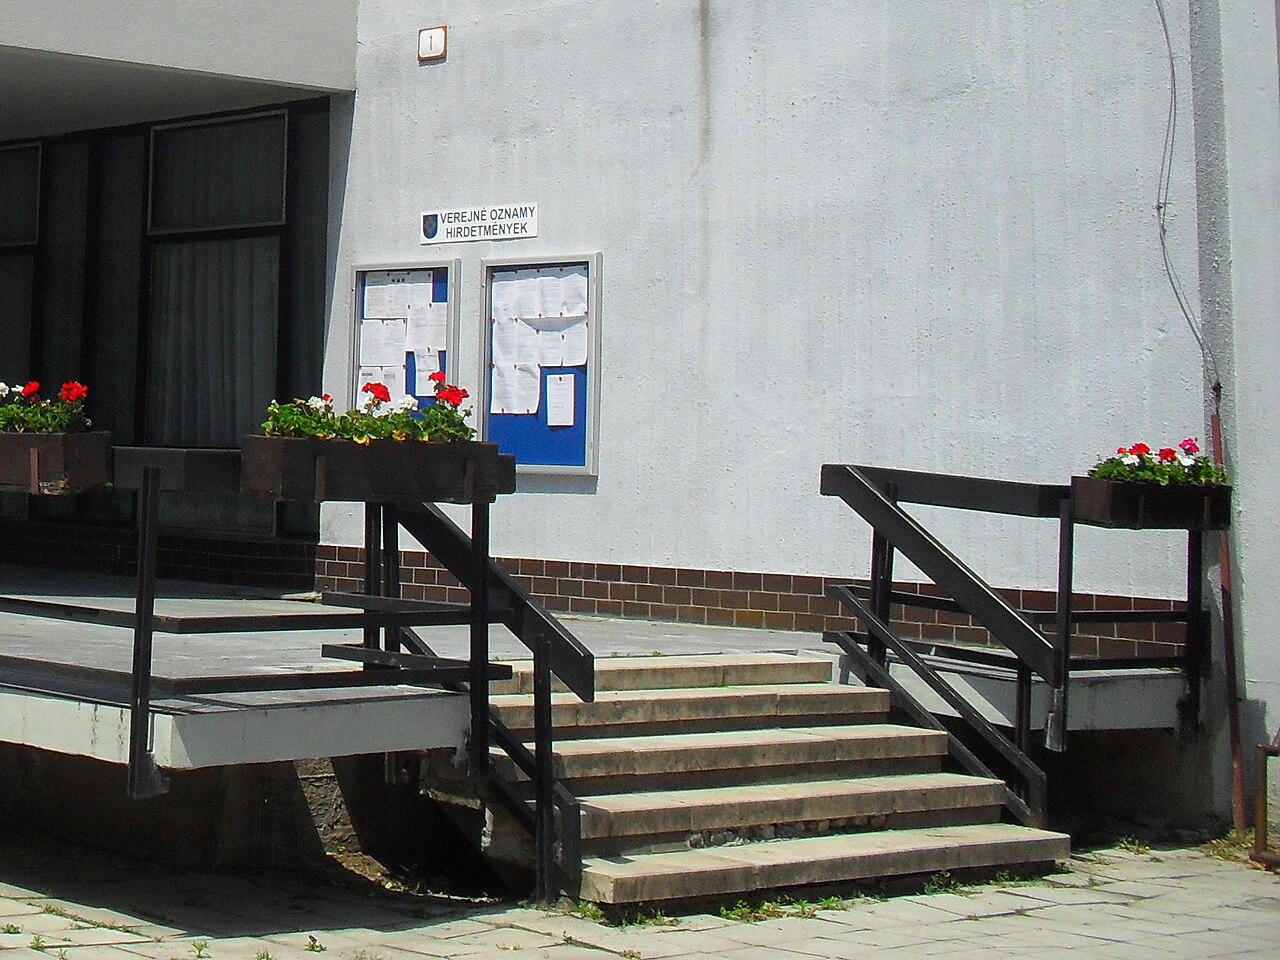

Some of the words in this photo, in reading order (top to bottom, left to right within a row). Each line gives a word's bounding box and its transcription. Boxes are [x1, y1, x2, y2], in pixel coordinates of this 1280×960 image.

[440, 207, 487, 224] VEREJNÉ
[490, 206, 536, 220] OZNAMY
[446, 221, 528, 239] HIRDETMÉNYEK
